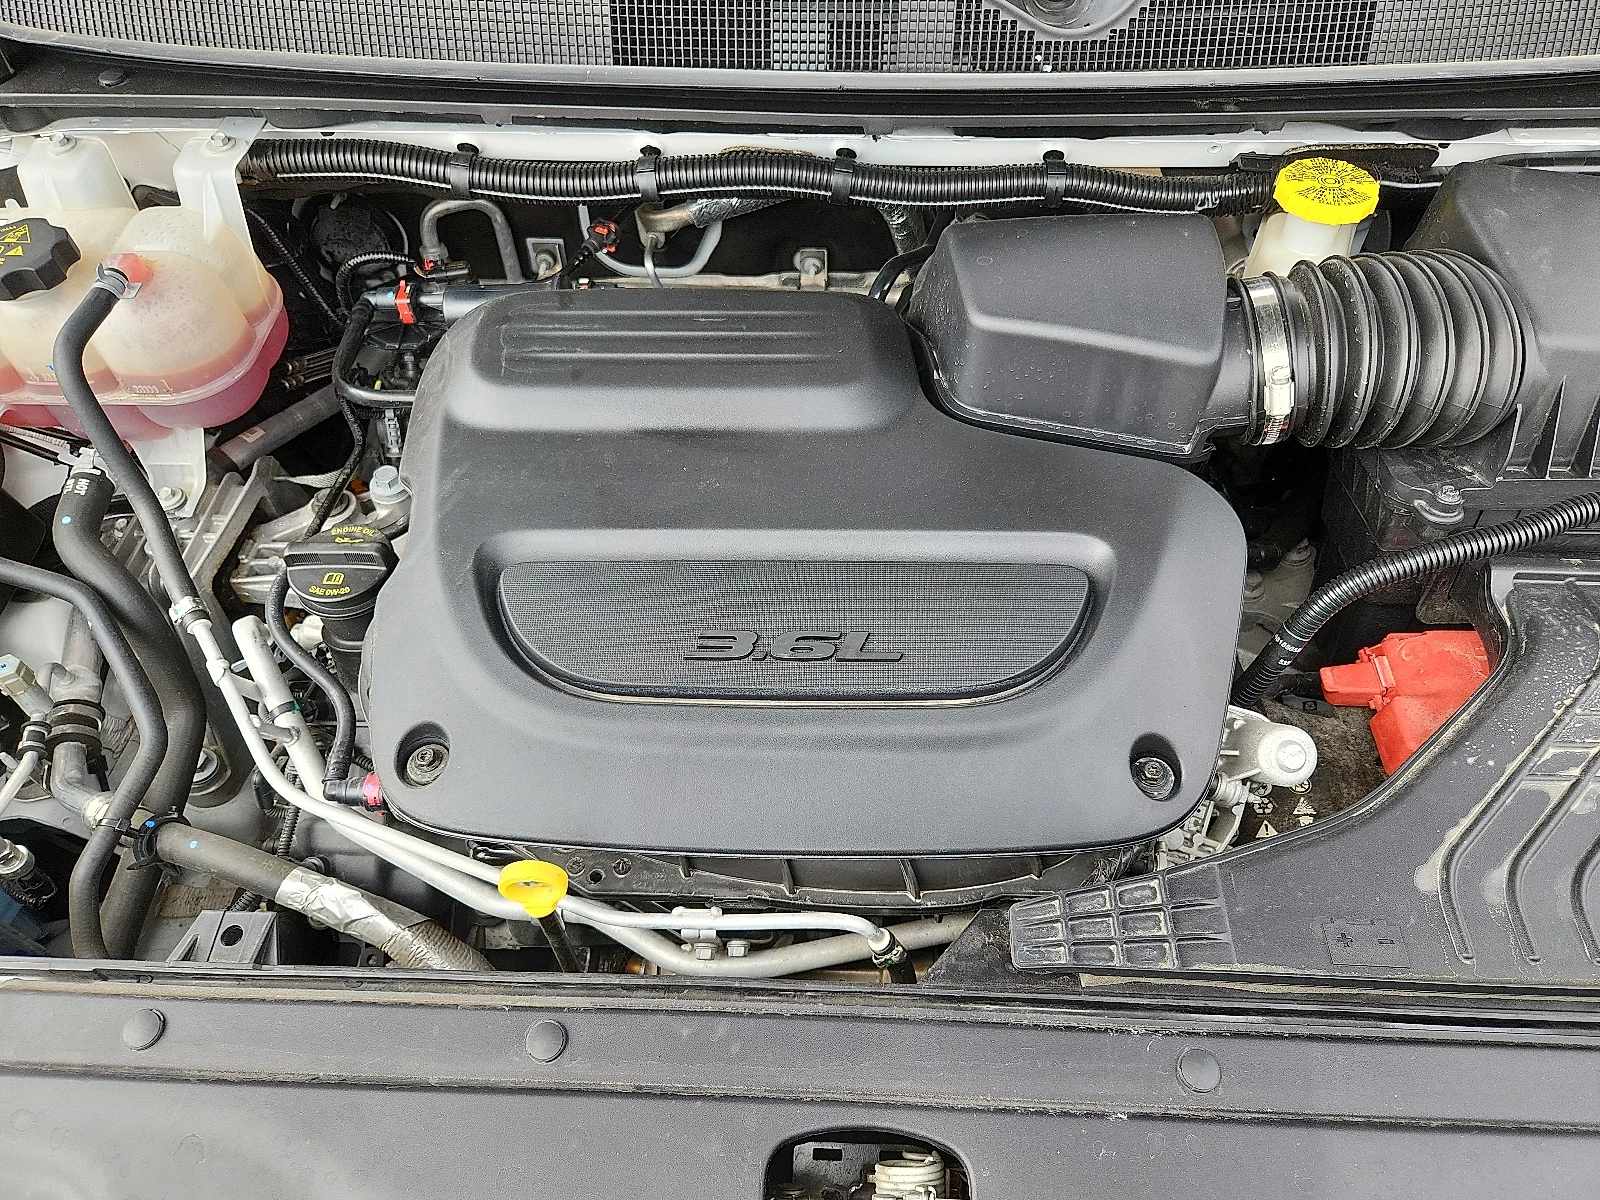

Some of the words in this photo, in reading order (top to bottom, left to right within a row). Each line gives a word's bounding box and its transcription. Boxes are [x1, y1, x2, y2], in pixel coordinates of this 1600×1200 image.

[74, 479, 90, 496] HOT
[331, 526, 363, 536] ENGINE
[363, 528, 376, 537] OIL
[309, 585, 325, 595] SAE
[326, 586, 350, 596] 0W-20
[683, 629, 904, 662] 3.6L
